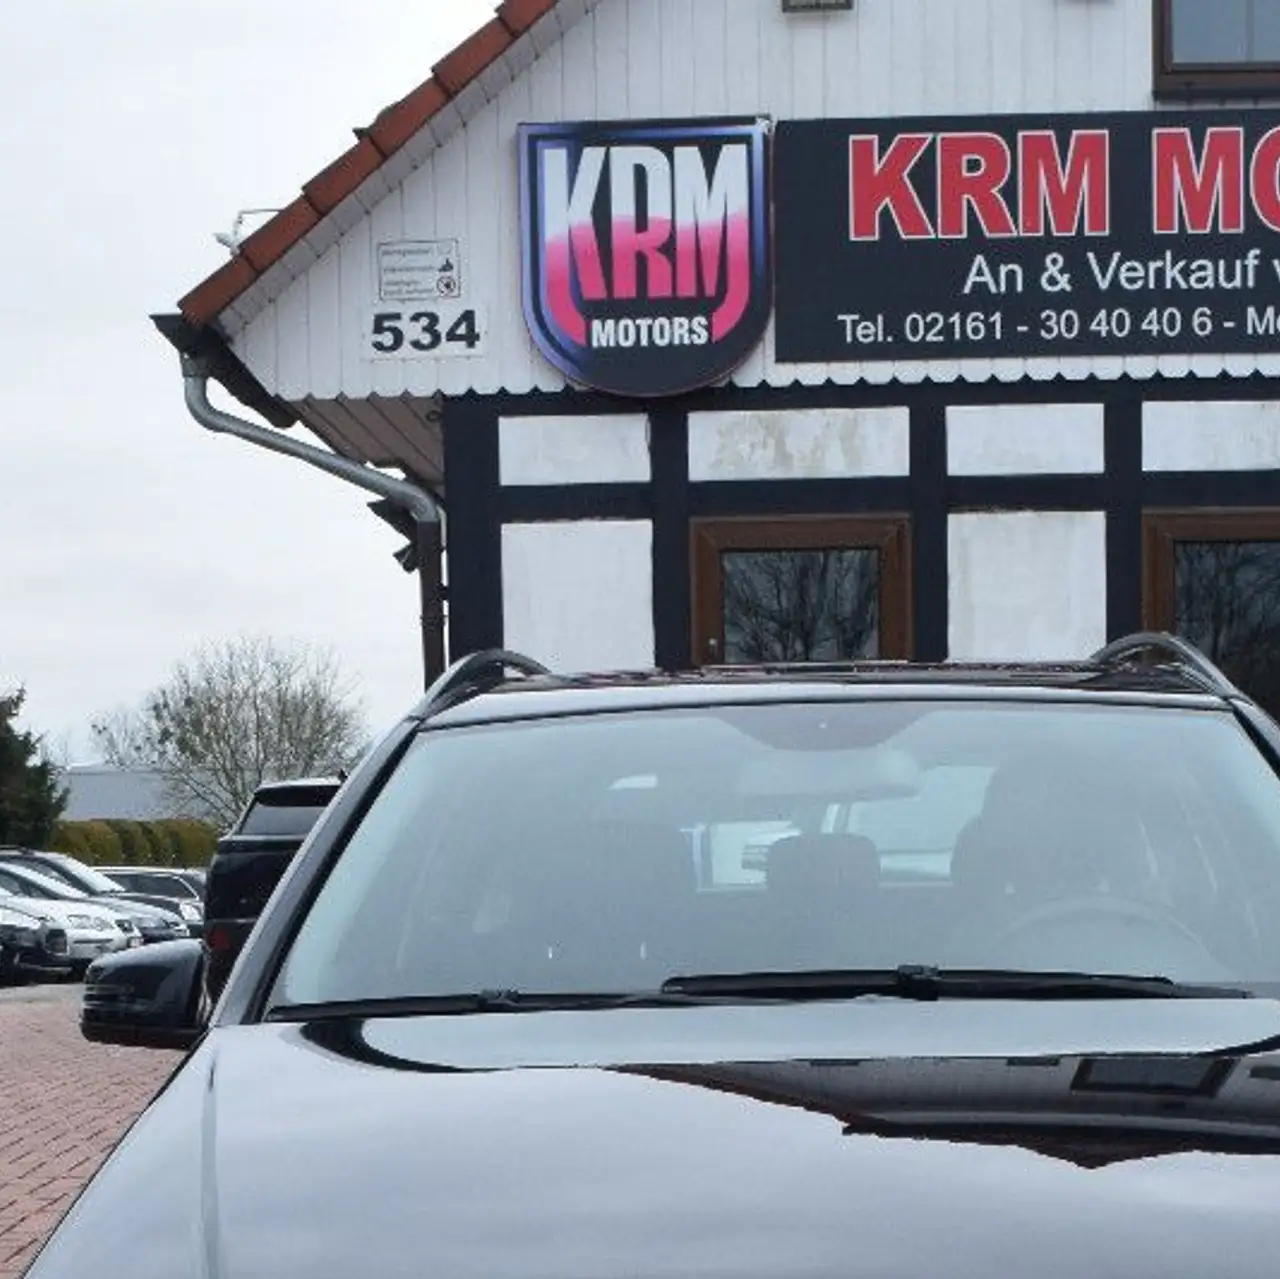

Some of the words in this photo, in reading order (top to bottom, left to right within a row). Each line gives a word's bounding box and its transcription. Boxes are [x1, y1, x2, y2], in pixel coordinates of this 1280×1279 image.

[848, 129, 1110, 241] KRM
[544, 143, 750, 347] KRM
[963, 253, 1023, 294] An
[1040, 252, 1072, 292] &
[1086, 248, 1261, 291] Verkauf
[371, 309, 480, 353] 534
[591, 316, 709, 348] MOTORS
[837, 313, 893, 343] Tel.
[905, 311, 1003, 343] 02161
[1040, 309, 1080, 339] 30
[1089, 308, 1131, 338] 40
[1141, 307, 1182, 338] 40
[1192, 306, 1213, 337] 6
